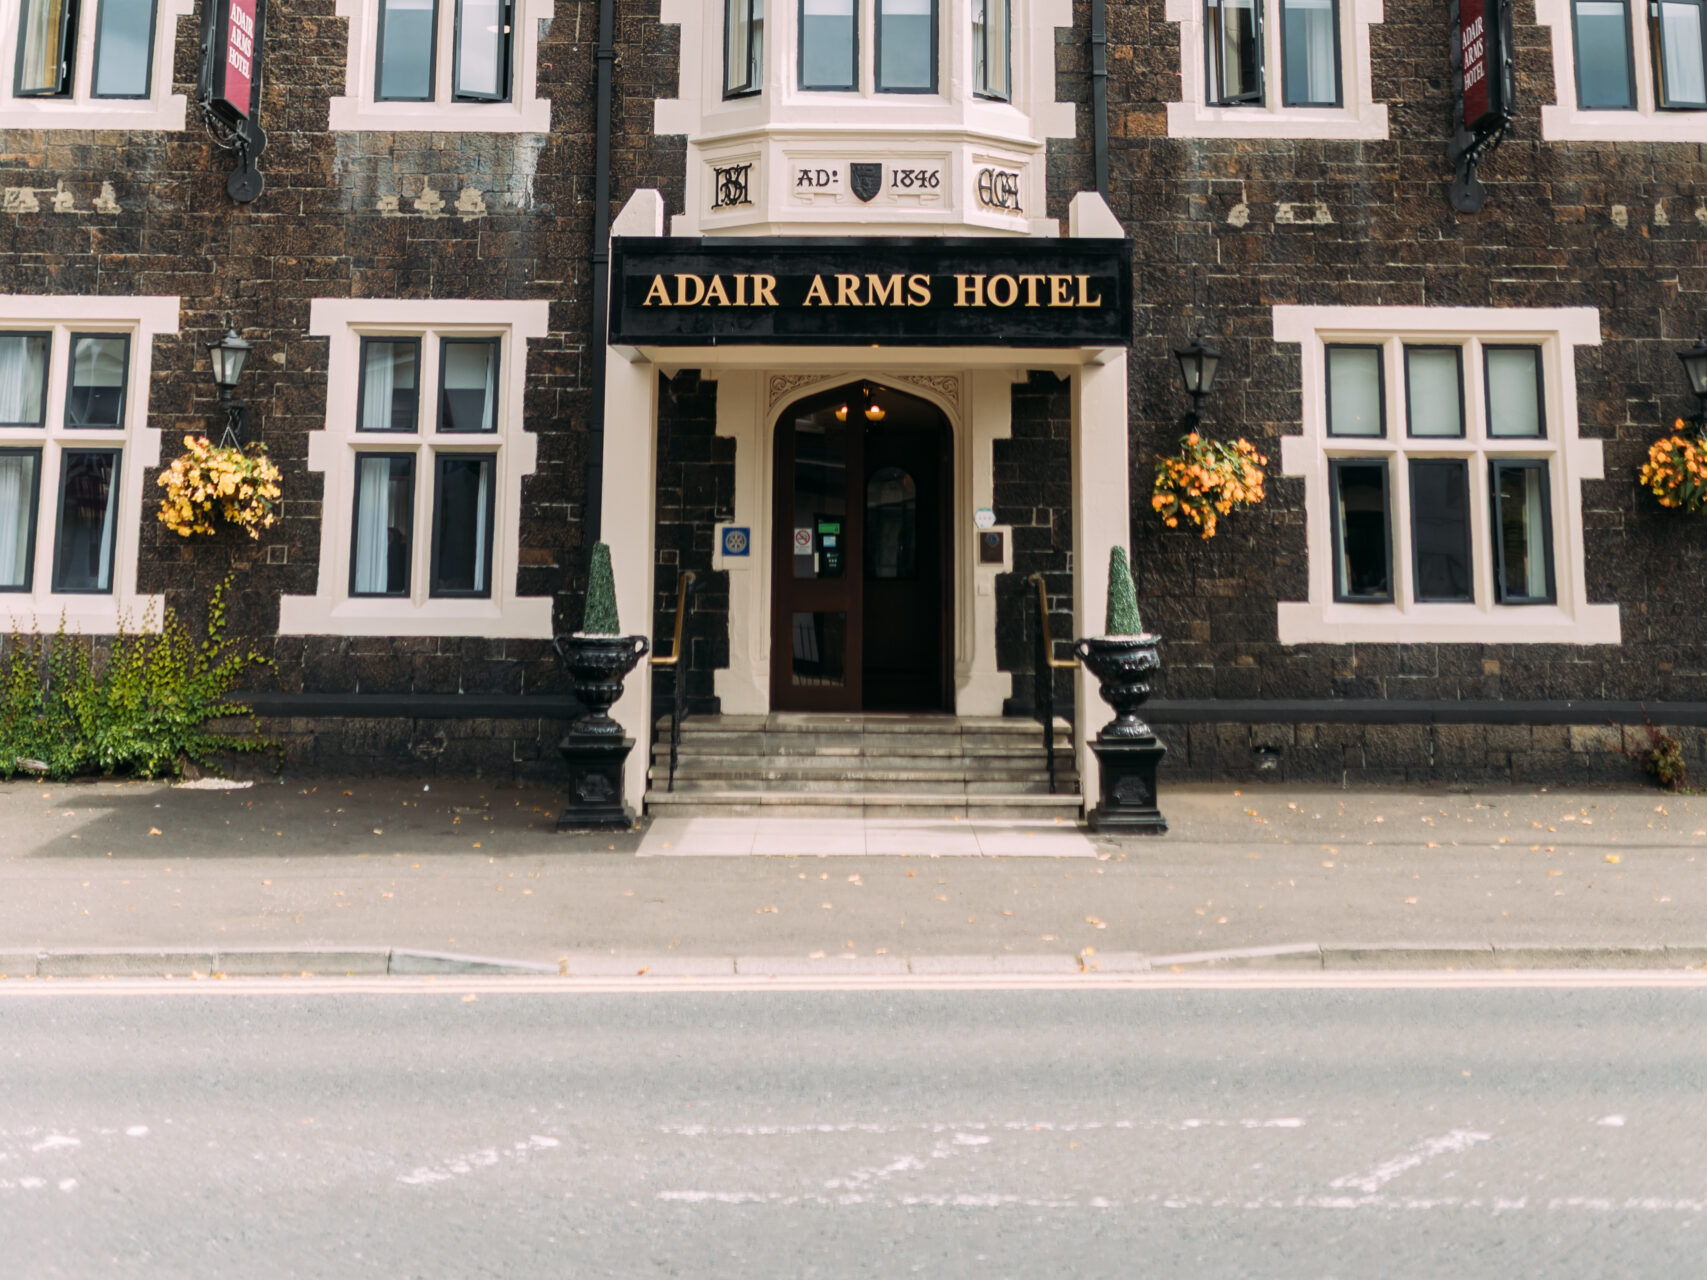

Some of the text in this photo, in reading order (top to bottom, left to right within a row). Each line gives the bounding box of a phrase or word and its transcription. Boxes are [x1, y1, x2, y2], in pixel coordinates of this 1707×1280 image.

[230, 3, 254, 39] ADAIR
[1462, 16, 1484, 50] ADAIR
[230, 25, 252, 58] ARMS
[1464, 37, 1484, 70] ARMS
[228, 46, 250, 79] HOTEL
[1464, 61, 1485, 91] HOTEL
[891, 169, 940, 188] 1846
[642, 273, 1102, 307] ADAIR ARMS HOTEL
